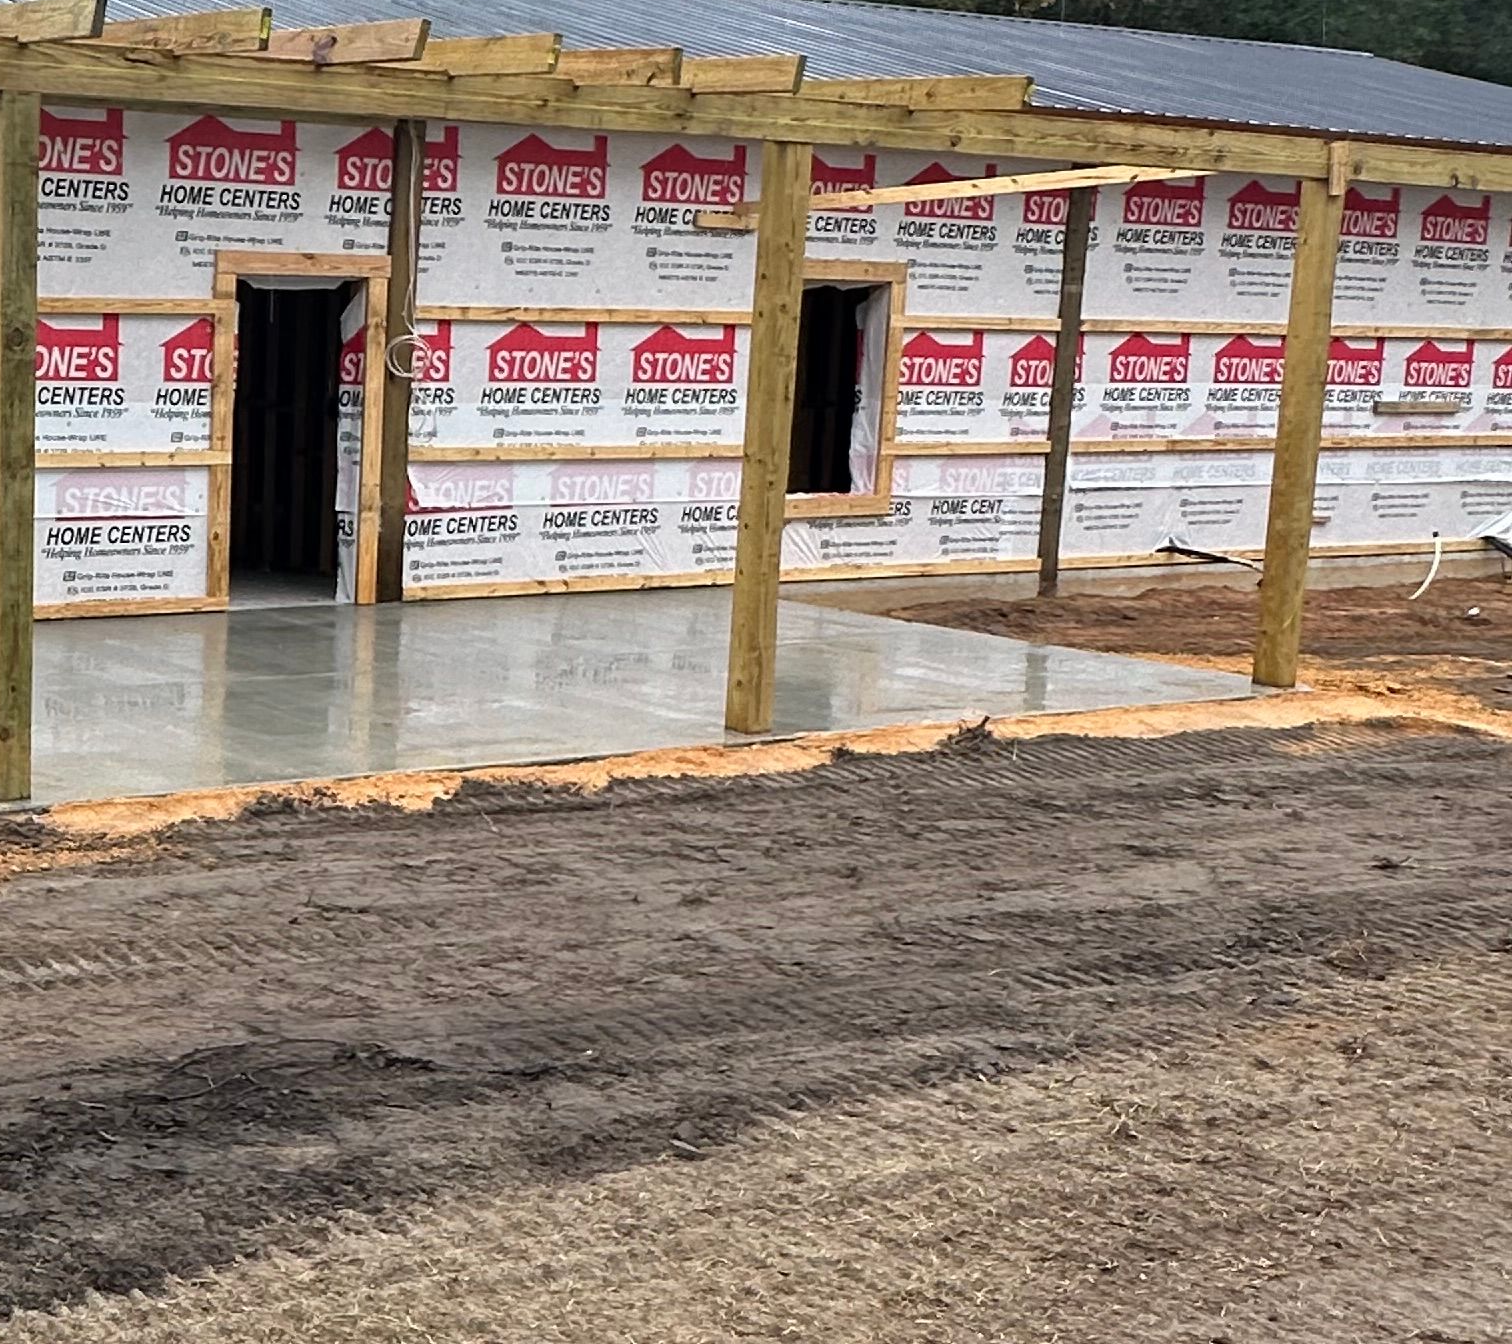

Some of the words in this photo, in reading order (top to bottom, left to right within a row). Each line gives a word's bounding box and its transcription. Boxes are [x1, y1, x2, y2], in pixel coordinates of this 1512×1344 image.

[39, 136, 119, 172] ONE'S
[174, 144, 292, 182] STONE'S
[502, 162, 603, 195] STONE'S
[648, 171, 741, 203] STONE'S
[41, 178, 130, 200] CENTERS
[160, 185, 214, 205] HOME
[219, 188, 301, 210] CENTERS
[328, 195, 380, 214] HOME
[488, 200, 536, 218] HOME
[540, 202, 610, 221] CENTERS
[1127, 197, 1201, 224] STONE'S
[635, 207, 679, 225] HOME
[815, 215, 878, 235] CENTERS
[898, 220, 935, 237] HOME
[939, 223, 997, 240] CENTERS
[1017, 228, 1051, 243] HOME
[1116, 229, 1149, 243] HOME
[1153, 231, 1205, 246] CENTERS
[1424, 216, 1486, 242] STONE'S
[1221, 234, 1252, 247] HOME
[1353, 242, 1400, 257] CENTERS
[1415, 245, 1443, 259] HOME
[1445, 248, 1489, 262] CENTERS
[36, 347, 114, 378] ONE'S
[493, 350, 593, 380] STONE'S
[638, 352, 732, 381] STONE'S
[1113, 356, 1186, 381] STONE'S
[1407, 362, 1469, 385] STONE'S
[38, 387, 125, 405] CENTERS
[155, 388, 208, 405] HOME
[481, 388, 527, 404] HOME
[531, 388, 601, 404] CENTERS
[625, 388, 665, 405] HOME
[670, 388, 737, 405] CENTERS
[926, 391, 984, 406] CENTERS
[1003, 392, 1039, 406] HOME
[1103, 388, 1136, 401] HOME
[1139, 388, 1191, 401] CENTERS
[1207, 388, 1238, 401] HOME
[1337, 391, 1382, 403] CENTERS
[558, 474, 651, 503] STONE'S
[681, 506, 723, 522] HOME
[932, 500, 967, 515] HOME
[408, 519, 442, 537] OME
[446, 515, 518, 534] CENTERS
[543, 512, 587, 528] HOME
[591, 508, 659, 526] CENTERS
[47, 527, 102, 545] HOME
[108, 525, 191, 543] CENTERS
